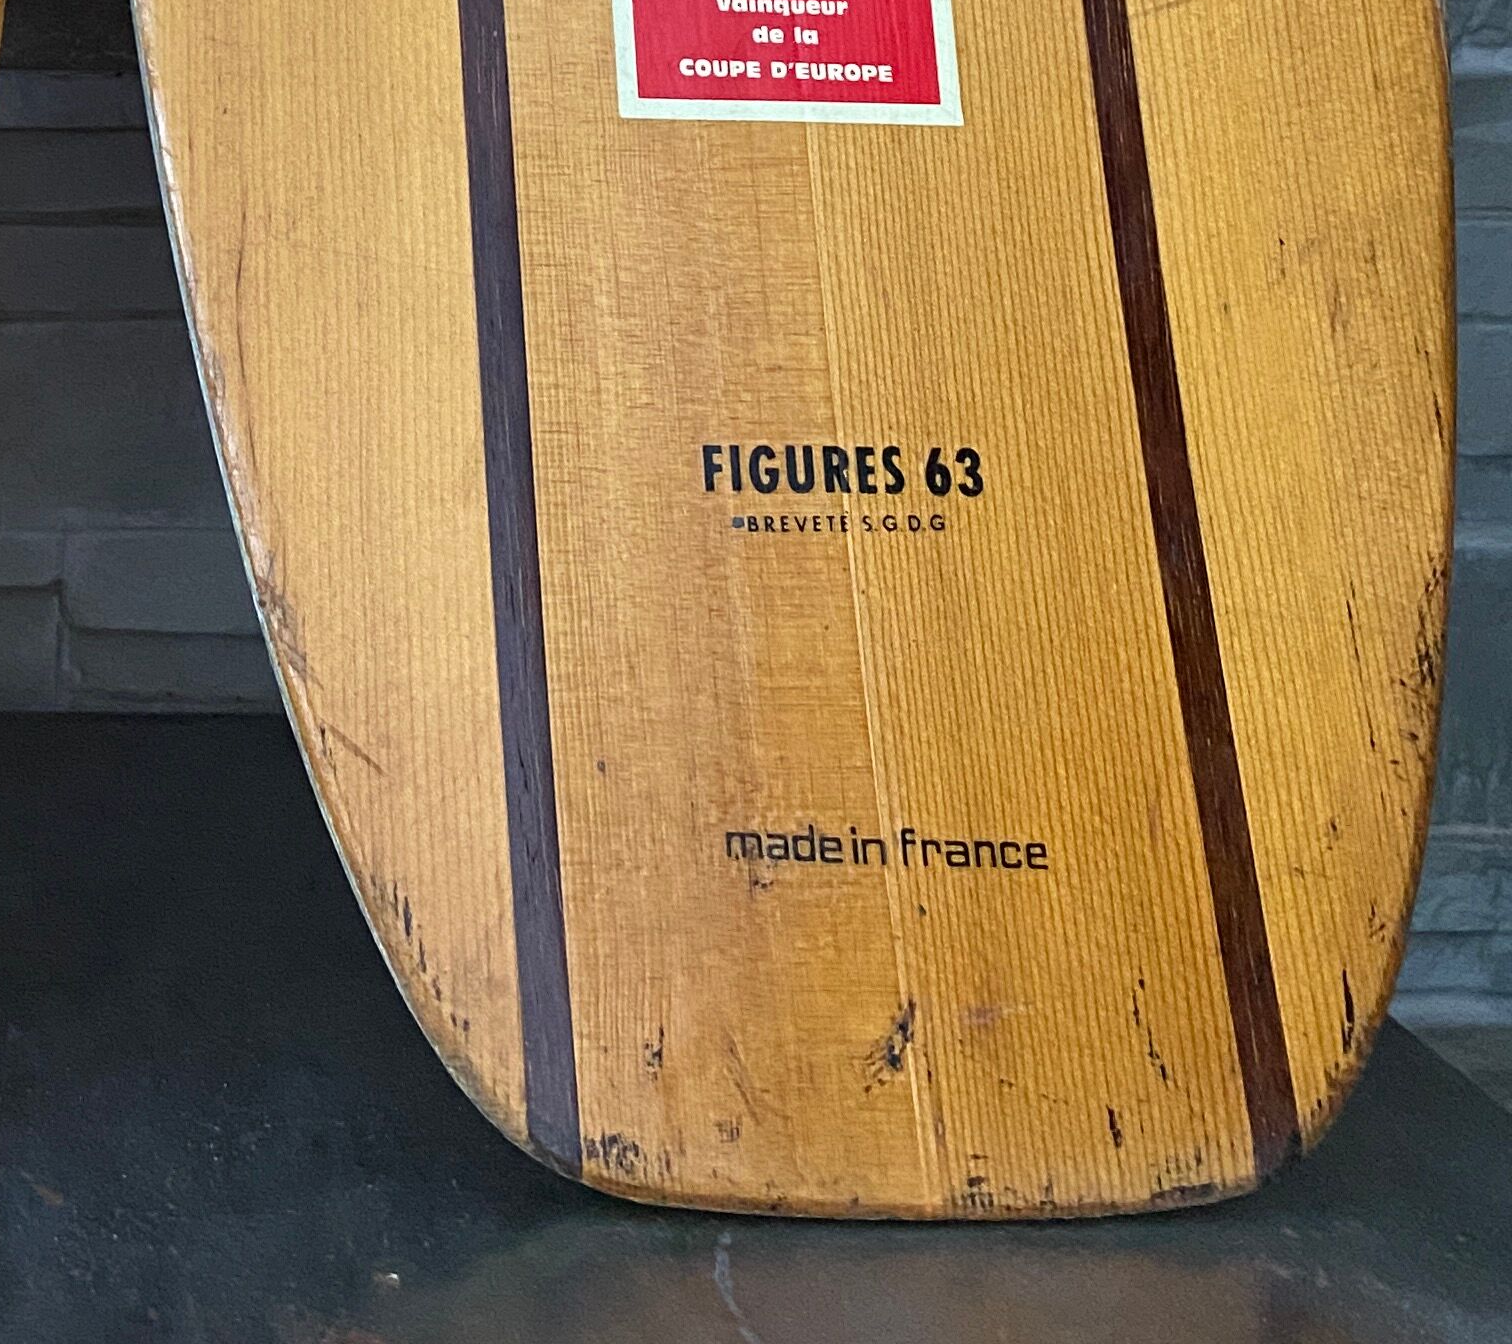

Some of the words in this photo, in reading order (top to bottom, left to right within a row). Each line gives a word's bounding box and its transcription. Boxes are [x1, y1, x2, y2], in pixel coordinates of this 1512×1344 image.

[752, 25, 784, 44] de
[794, 26, 819, 45] la
[678, 58, 761, 79] COUPE
[771, 61, 894, 83] D'EUROPE
[701, 444, 906, 495] FIGURES
[924, 446, 985, 497] 63
[726, 825, 843, 864] made
[850, 826, 887, 867] in
[900, 828, 1049, 870] france
